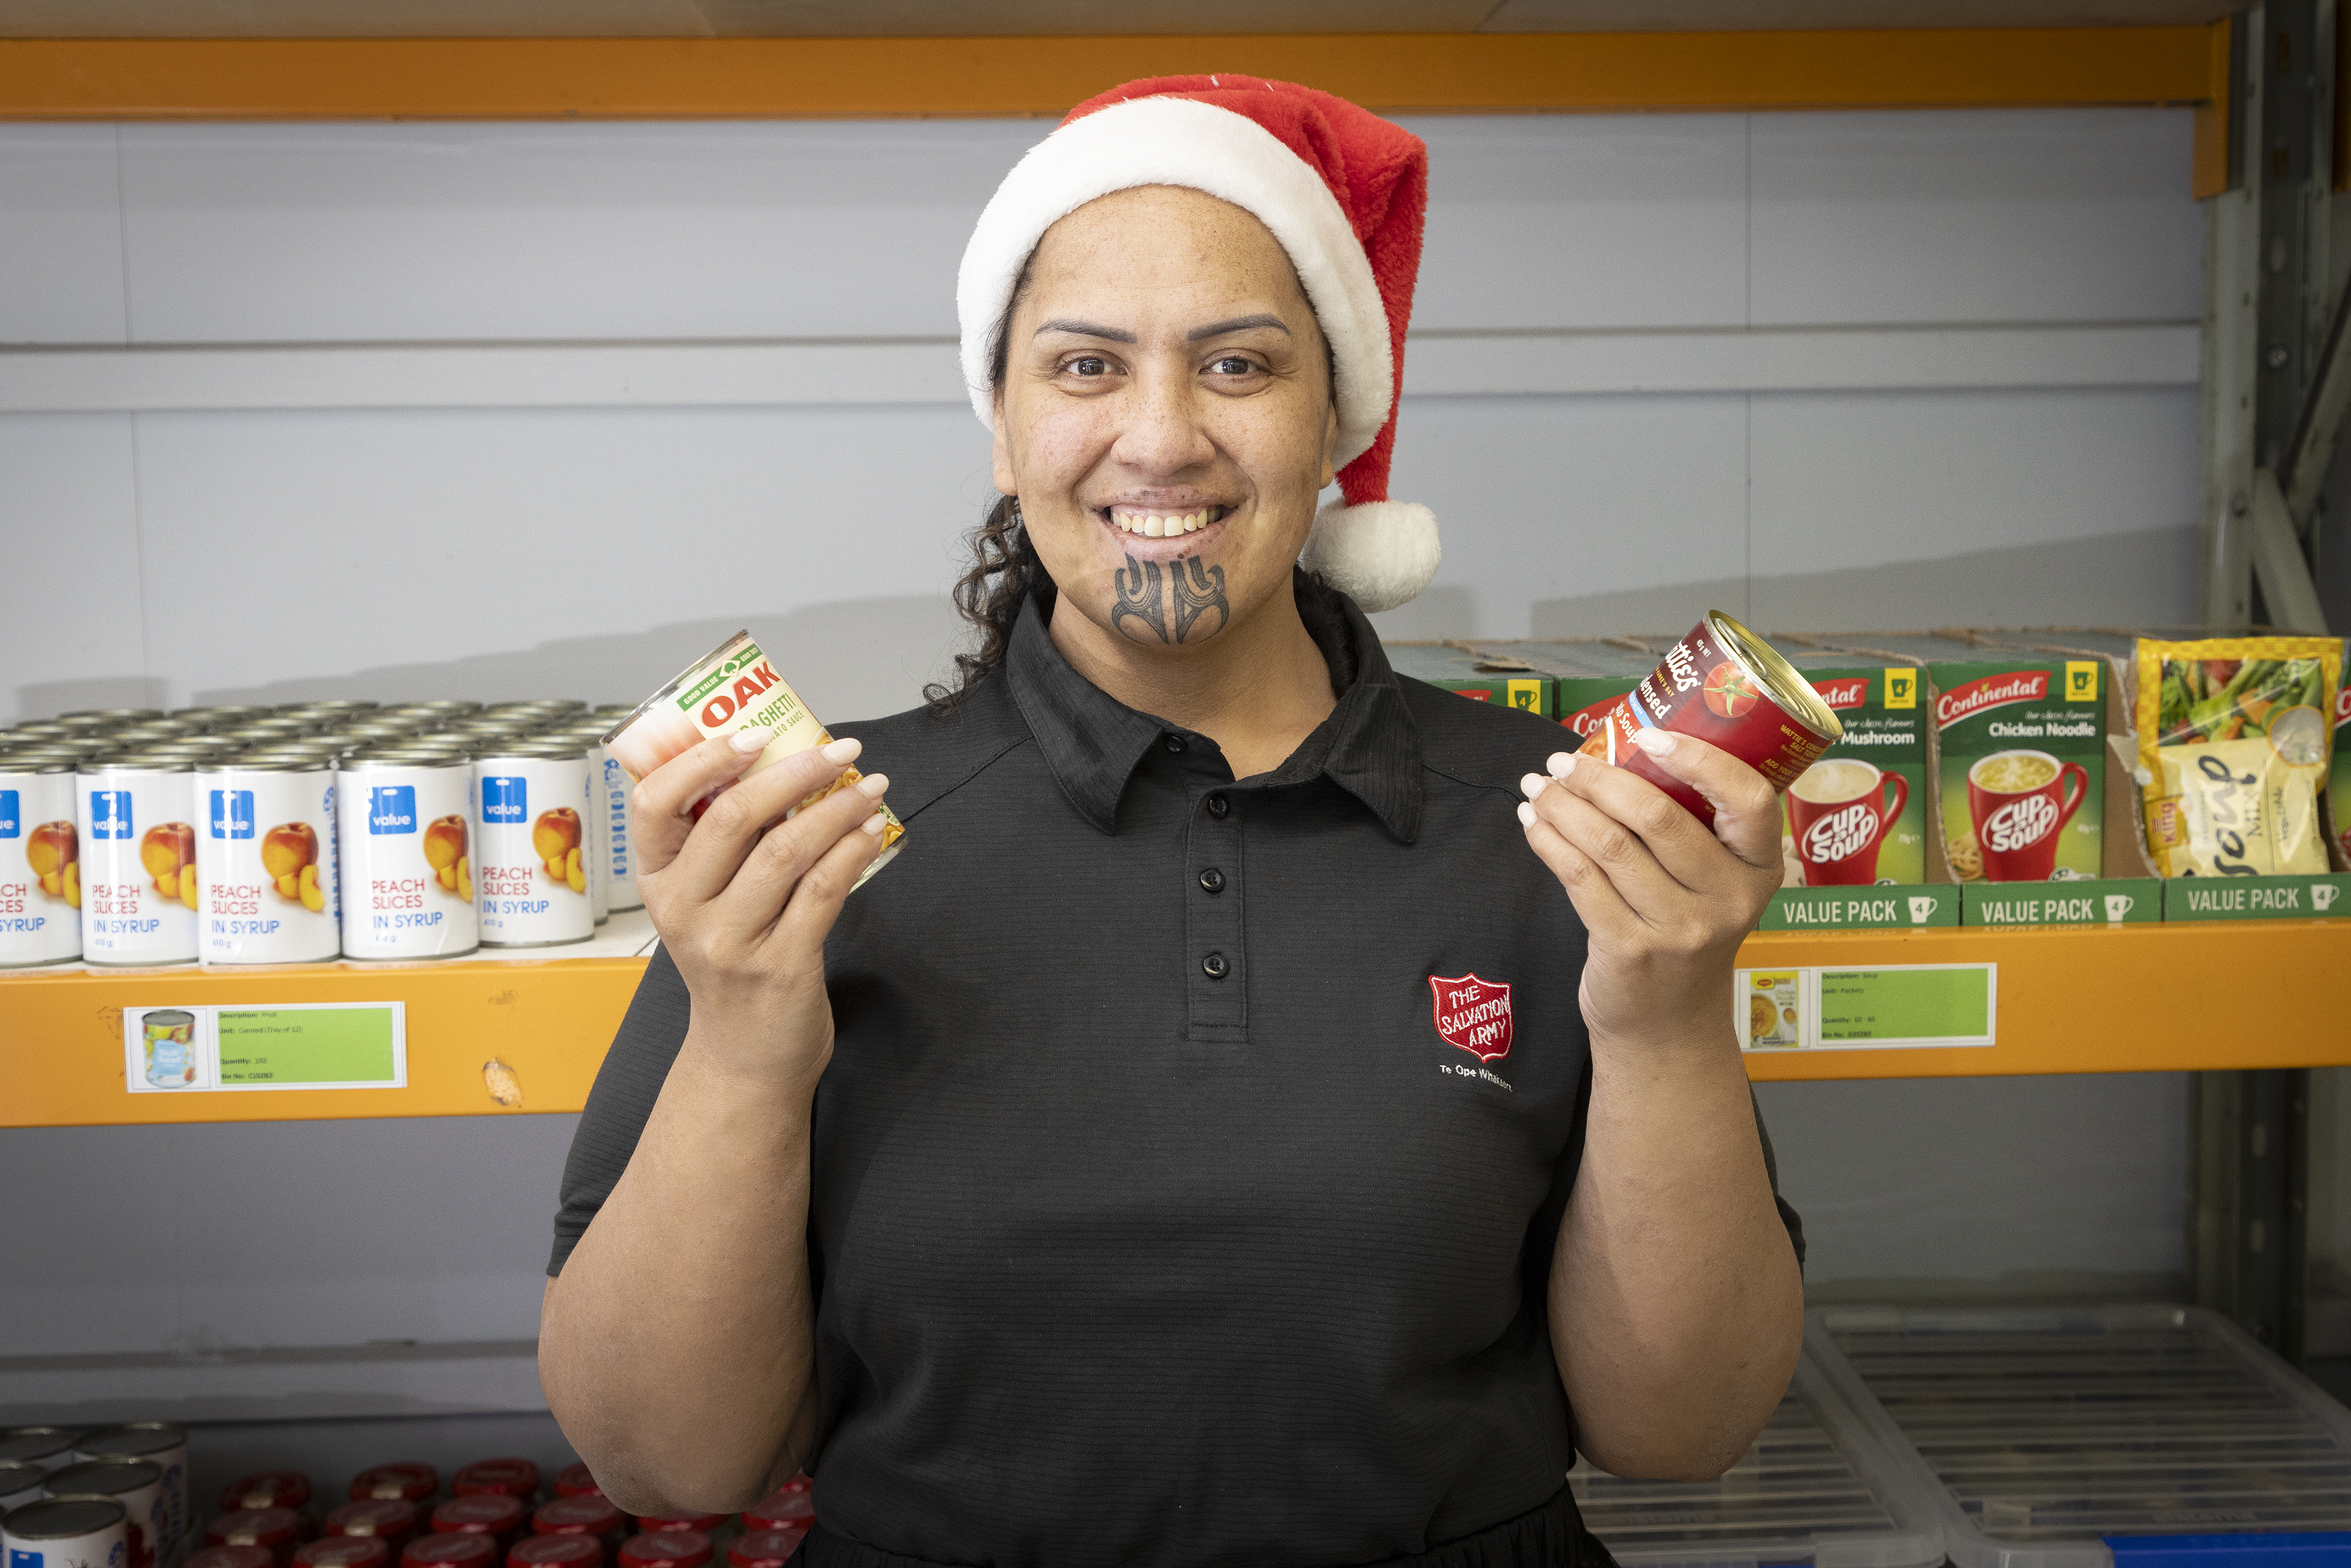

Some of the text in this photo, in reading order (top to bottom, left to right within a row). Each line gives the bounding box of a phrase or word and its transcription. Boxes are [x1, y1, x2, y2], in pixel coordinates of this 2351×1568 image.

[740, 651, 751, 662] GOOD
[1703, 648, 1712, 658] NET
[683, 676, 719, 705] GOOD VALUE
[700, 660, 780, 729] OAK
[1640, 674, 1672, 720] densed
[1665, 685, 1675, 697] BAY
[1938, 676, 2040, 721] Continental
[1520, 697, 1527, 706] 4
[786, 710, 805, 727] SAUCE
[1844, 717, 1915, 731] Our classic flavours
[1618, 712, 1638, 744] Soup
[1780, 724, 1808, 746] WATTIE'S
[1989, 721, 2096, 738] Chicken Noodle
[1840, 729, 1915, 745] Mushroom
[1790, 742, 1805, 752] SALT
[1765, 758, 1779, 769] ADD
[1778, 766, 1793, 776] YOUR
[486, 803, 522, 816] value
[1990, 794, 2046, 833] CUP
[372, 813, 411, 827] value
[1810, 804, 1866, 843] CUP
[1991, 804, 2054, 853] SOUP
[1811, 814, 1875, 863] SOUP
[482, 866, 533, 881] PEACH
[92, 885, 141, 898] PEACH
[210, 885, 261, 899] PEACH
[372, 878, 425, 894] PEACH
[483, 881, 530, 896] SLICES
[92, 900, 138, 915] SLICES
[372, 894, 423, 910] SLICES
[483, 900, 549, 914] IN SYRUP
[2188, 888, 2325, 911] VALUE PACK 4
[211, 901, 259, 915] SLICES
[1783, 900, 1924, 924] VALUE PACK 4
[1981, 898, 2119, 923] VALUE PACK 4
[94, 918, 160, 934] IN SYRUP
[211, 919, 280, 935] IN SYRUP
[373, 912, 443, 929] IN SYRUP
[483, 918, 504, 929] 410 g
[211, 938, 224, 948] 410
[1449, 985, 1480, 1009] THE
[1441, 994, 1510, 1035] SALVATION
[1469, 1017, 1507, 1047] ARMY
[1439, 1064, 1452, 1074] Te
[1455, 1064, 1477, 1077] Ope
